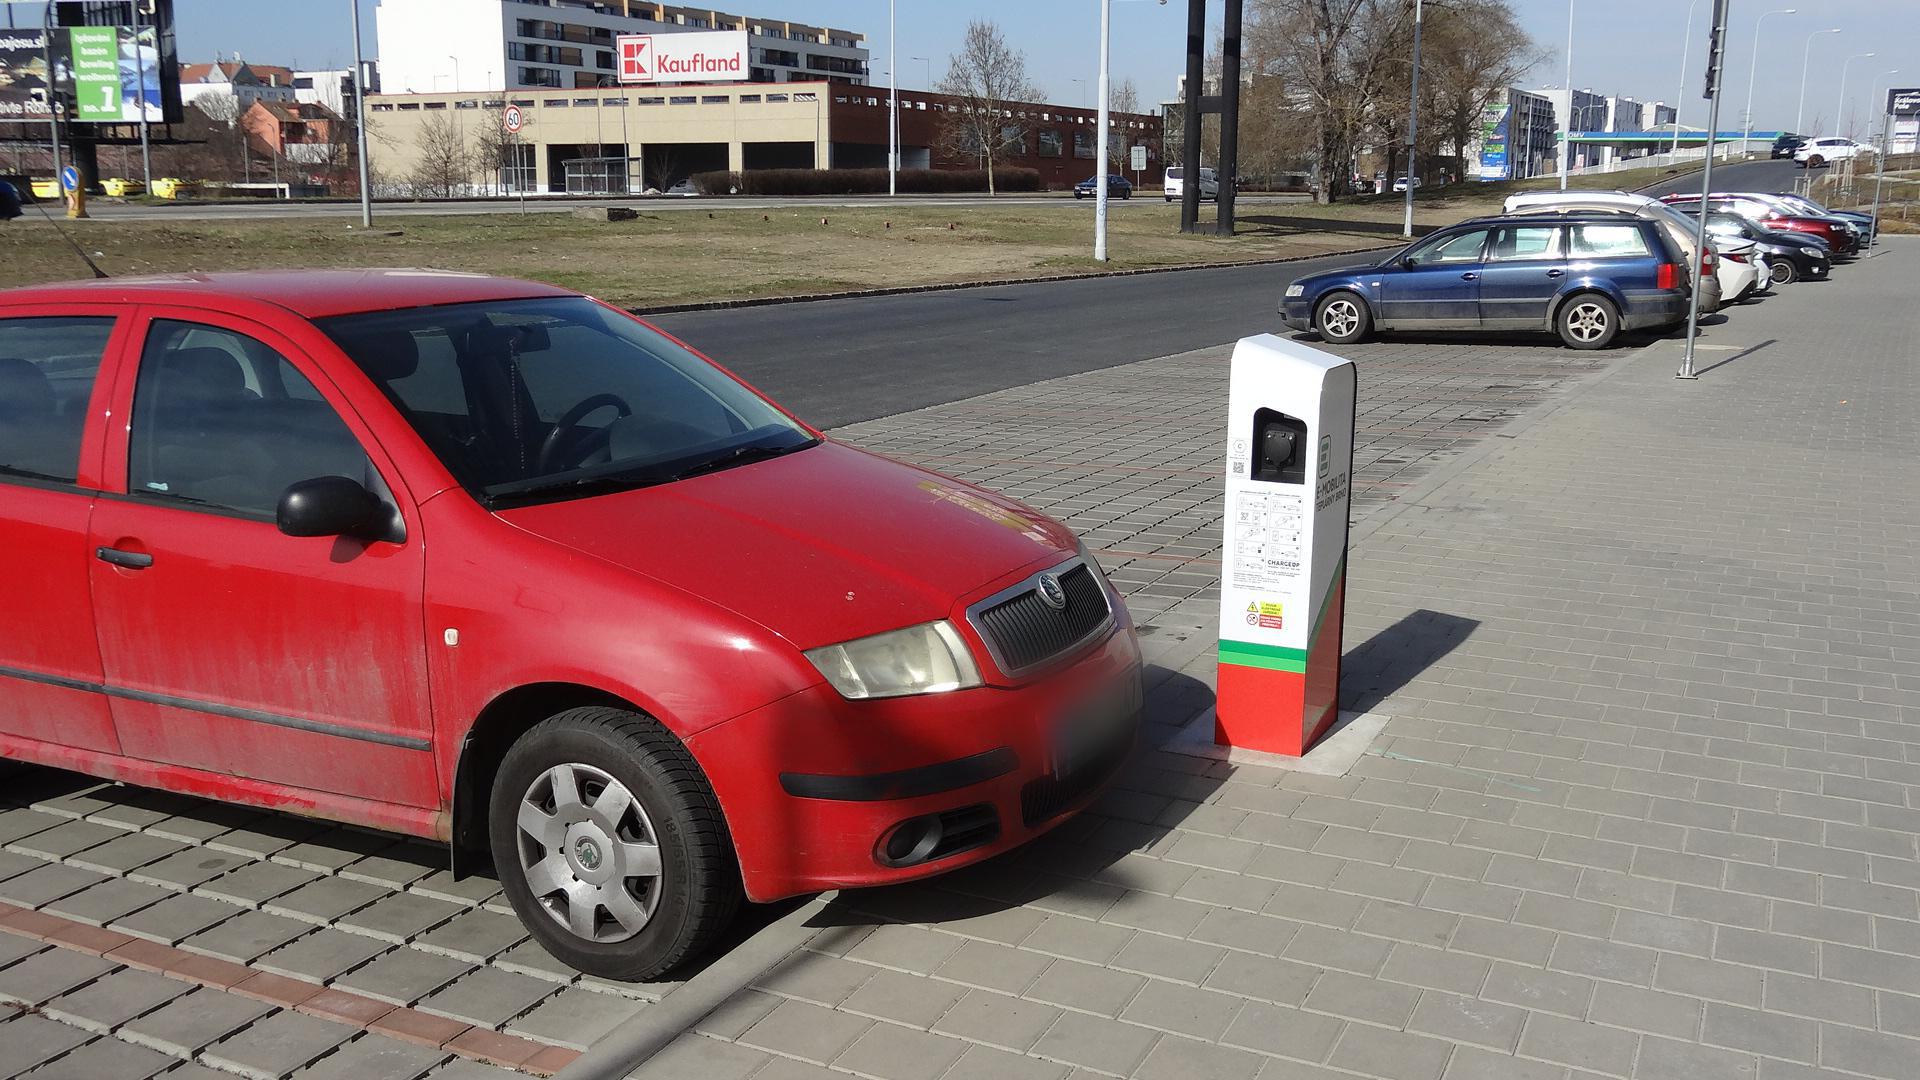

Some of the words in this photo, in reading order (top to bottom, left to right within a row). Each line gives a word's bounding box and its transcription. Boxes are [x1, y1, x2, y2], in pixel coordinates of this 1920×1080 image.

[79, 60, 115, 70] bowling
[657, 53, 740, 74] Kaufland
[79, 73, 118, 82] wellness
[508, 113, 519, 126] 60
